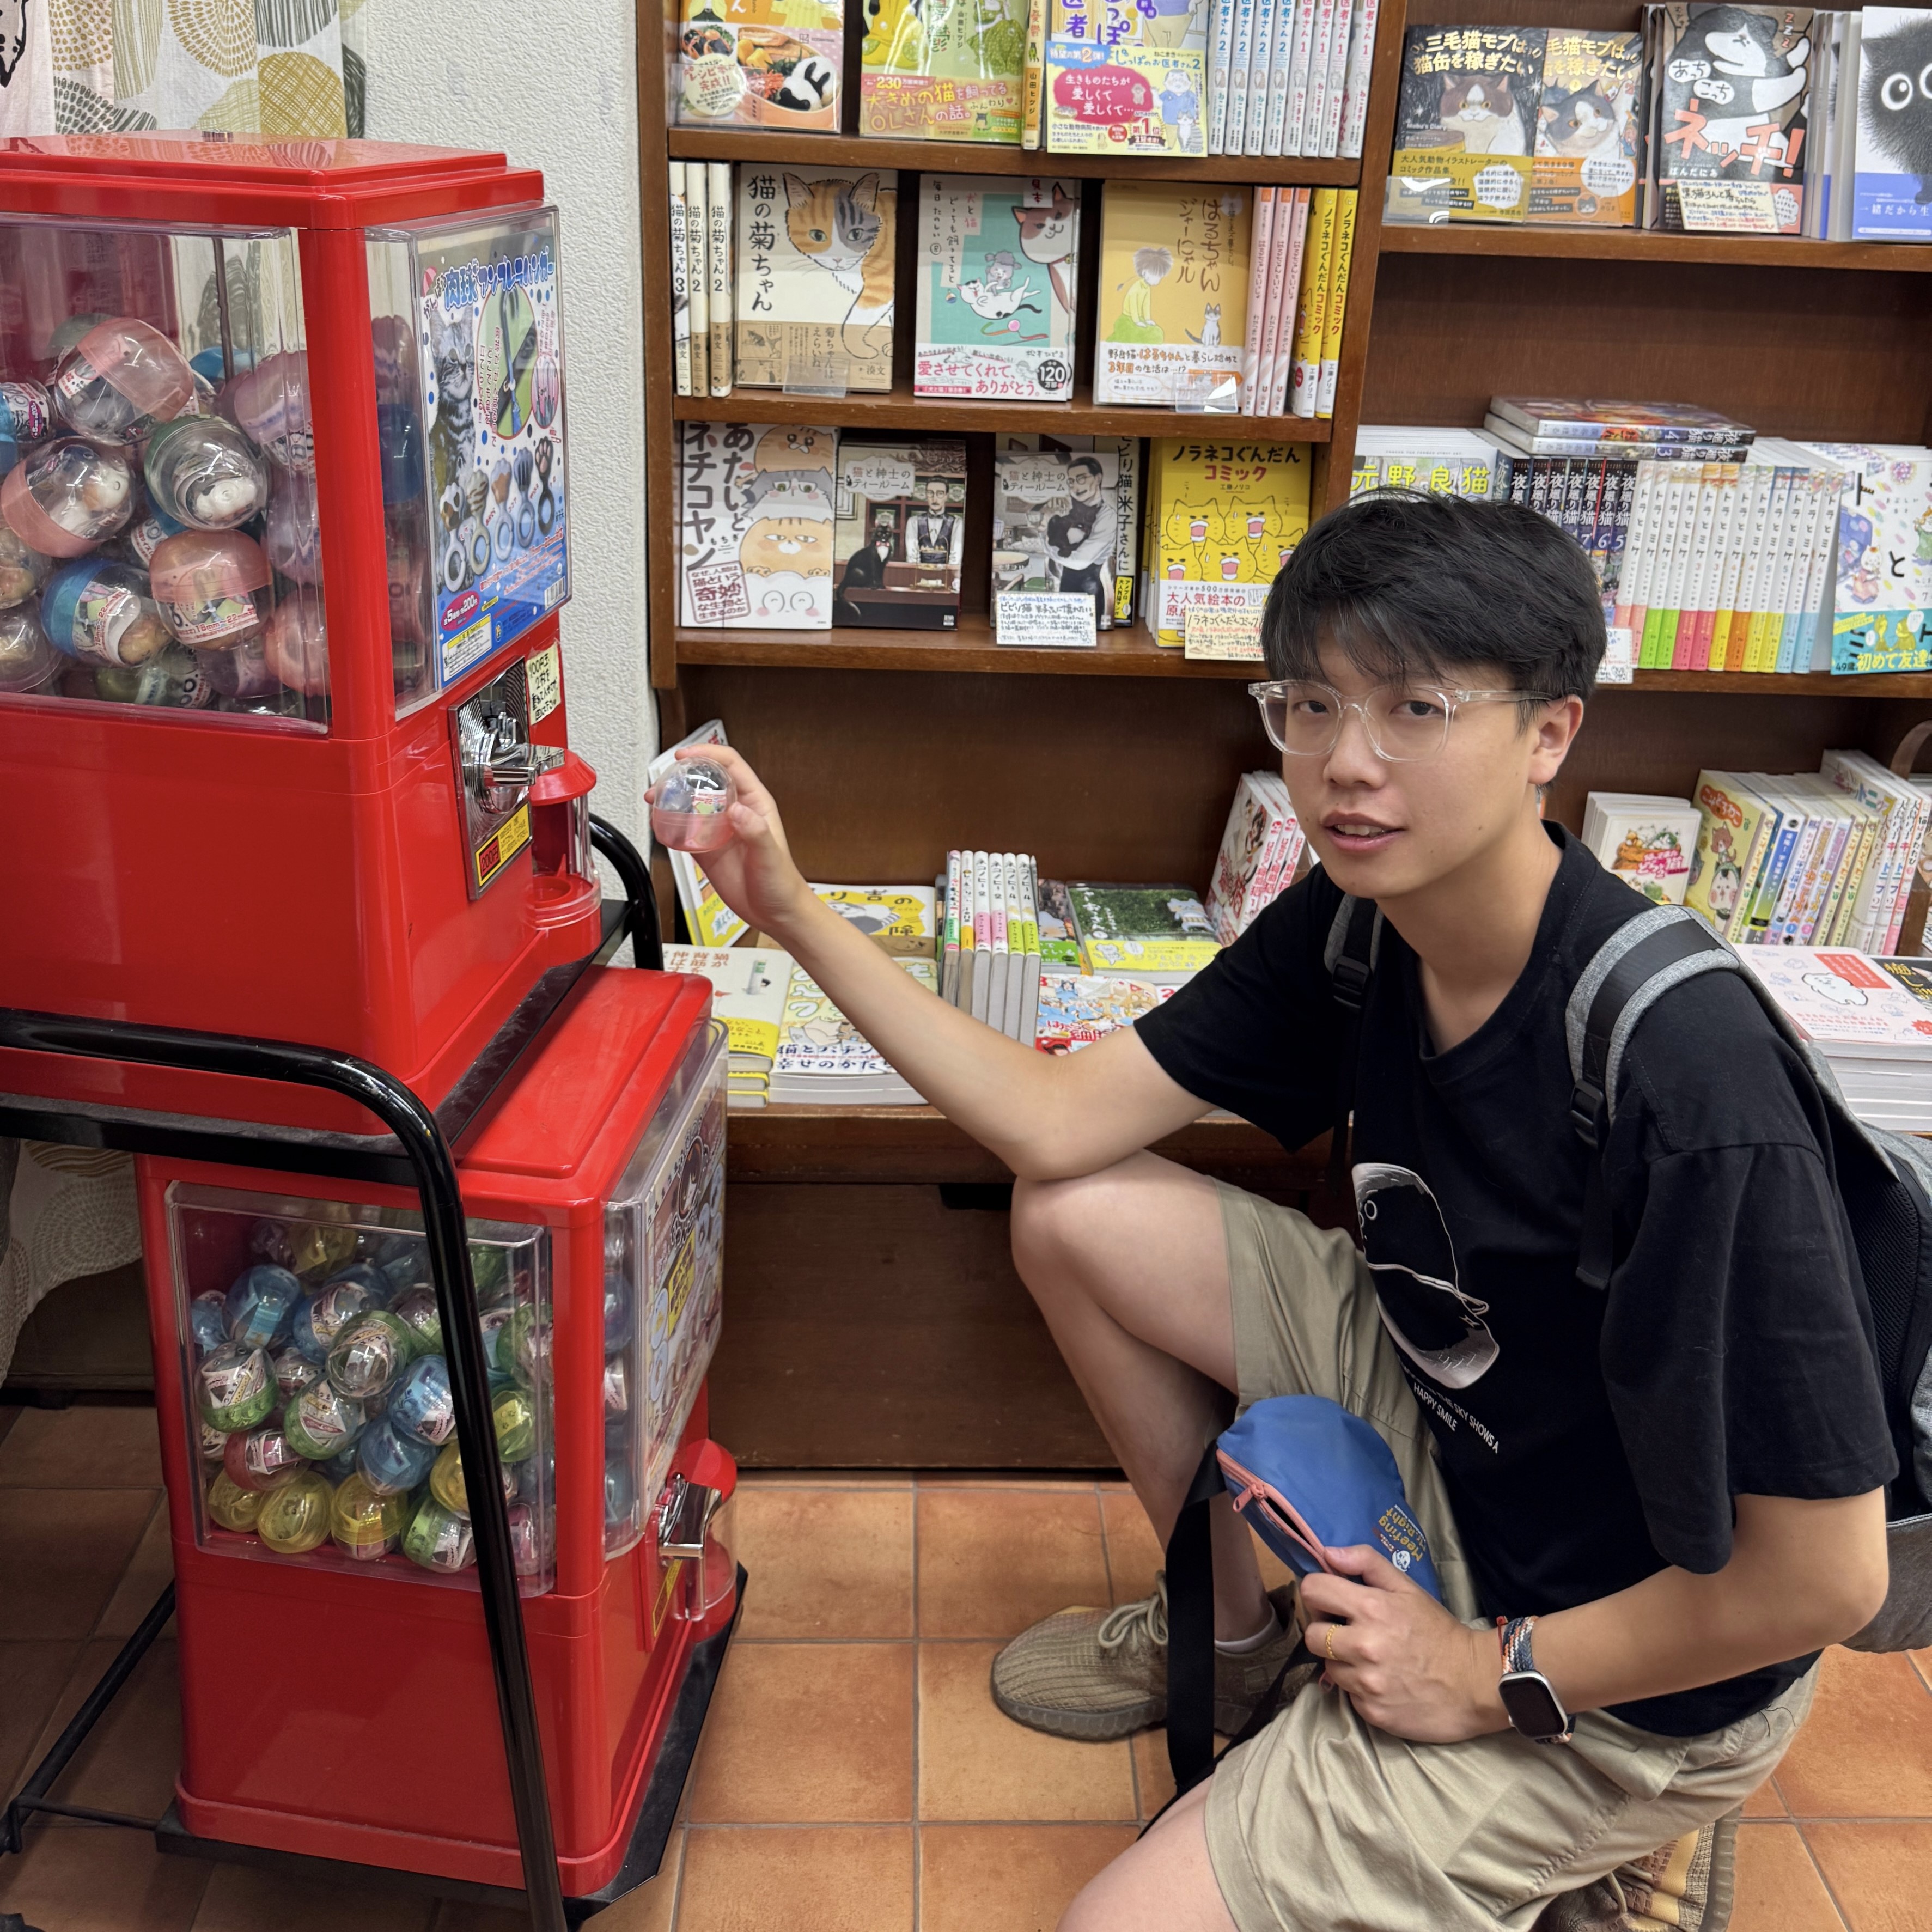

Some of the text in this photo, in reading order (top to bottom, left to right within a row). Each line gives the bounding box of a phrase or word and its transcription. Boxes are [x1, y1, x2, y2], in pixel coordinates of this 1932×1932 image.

[1219, 41, 1226, 51] 2
[1239, 42, 1246, 52] 2
[1259, 43, 1266, 53] 2
[1279, 42, 1286, 52] 2
[1301, 42, 1306, 53] 1
[1320, 42, 1325, 53] 1
[1338, 44, 1343, 54] 1
[1363, 45, 1368, 55] 1
[1425, 31, 1526, 54] 三毛猫モブは
[1413, 50, 1534, 75] 猫缶を稼ぎたい
[1674, 61, 1705, 79] あっち
[1066, 75, 1130, 86] 生きものたちが
[1071, 86, 1112, 101] 愛しくて
[1701, 83, 1730, 99] こっち
[1664, 99, 1805, 178] ネッチ!
[1400, 156, 1507, 166] 大人気動物イラストレーターの
[1400, 166, 1453, 175] コミック作品集。
[671, 204, 685, 292] 猫の菊ちゃん 3
[689, 205, 702, 291] 猫の菊ちゃん 2
[712, 205, 724, 291] 猫の菊ちゃん 2
[748, 175, 776, 312] 猫の菊ちゃん
[1176, 199, 1198, 283] ジャーにゃル
[1200, 199, 1222, 293] はるちゃん
[1313, 209, 1333, 334] ノラネコぐんだんコミック
[1331, 209, 1352, 335] ノラネコぐんだんコミック
[918, 361, 1015, 380] 愛させてくれて、
[1039, 367, 1065, 382] 120
[976, 381, 1040, 397] ありがとう。
[1664, 430, 1679, 440] 4
[1172, 445, 1300, 463] ノラネコぐんだん
[1657, 448, 1672, 457] 3
[722, 423, 755, 533] あたいと
[851, 479, 910, 490] ティールーム
[854, 467, 911, 479] 猫と紳士の
[1009, 471, 1065, 483] 猫と紳士の
[1009, 483, 1065, 492] ティールーム
[1204, 464, 1266, 482] コミック
[1352, 465, 1490, 494] 元野良猫
[684, 423, 718, 571] ネチコヤン
[1511, 472, 1527, 505] 夜廻
[1531, 472, 1547, 514] 夜廻り
[1563, 471, 1583, 525] 夜廻り猫
[1581, 472, 1601, 545] 夜廻り猫 7
[1598, 472, 1619, 548] 夜廻り猫 6
[1613, 473, 1635, 549] 夜廻り猫 5
[1632, 490, 1647, 556] トラとミケ
[1647, 491, 1662, 557] トラとミケ
[1662, 491, 1679, 557] トラとミケ
[1679, 491, 1695, 557] トラとミケ
[1696, 492, 1713, 558] トラとミケ
[1715, 492, 1731, 558] トラとミケ
[1732, 493, 1749, 559] トラとミケ
[1750, 493, 1767, 559] トラとミケ
[1767, 494, 1784, 560] トラとミケ
[1784, 495, 1801, 561] トラとミケ
[1800, 495, 1817, 562] トラとミケ
[1819, 496, 1836, 562] トラとミケ
[1889, 551, 1905, 577] と
[693, 572, 741, 587] 猫という
[695, 582, 741, 601] 奇妙
[1167, 592, 1245, 606] 大人気絵本の
[482, 846, 499, 871] 200円
[976, 859, 986, 887] ネコノヒー
[991, 861, 1001, 890] ネコノヒー
[1005, 861, 1016, 889] ネコノヒー
[1019, 862, 1029, 891] ネコノヒー
[1414, 1382, 1437, 1410] HAPPY
[1437, 1404, 1458, 1432] SMILE
[1453, 1403, 1470, 1421] SKY
[1469, 1415, 1493, 1448] SHOWS
[1492, 1441, 1500, 1454] A
[1386, 1508, 1415, 1538] Right
[1379, 1515, 1424, 1562] Meeting
